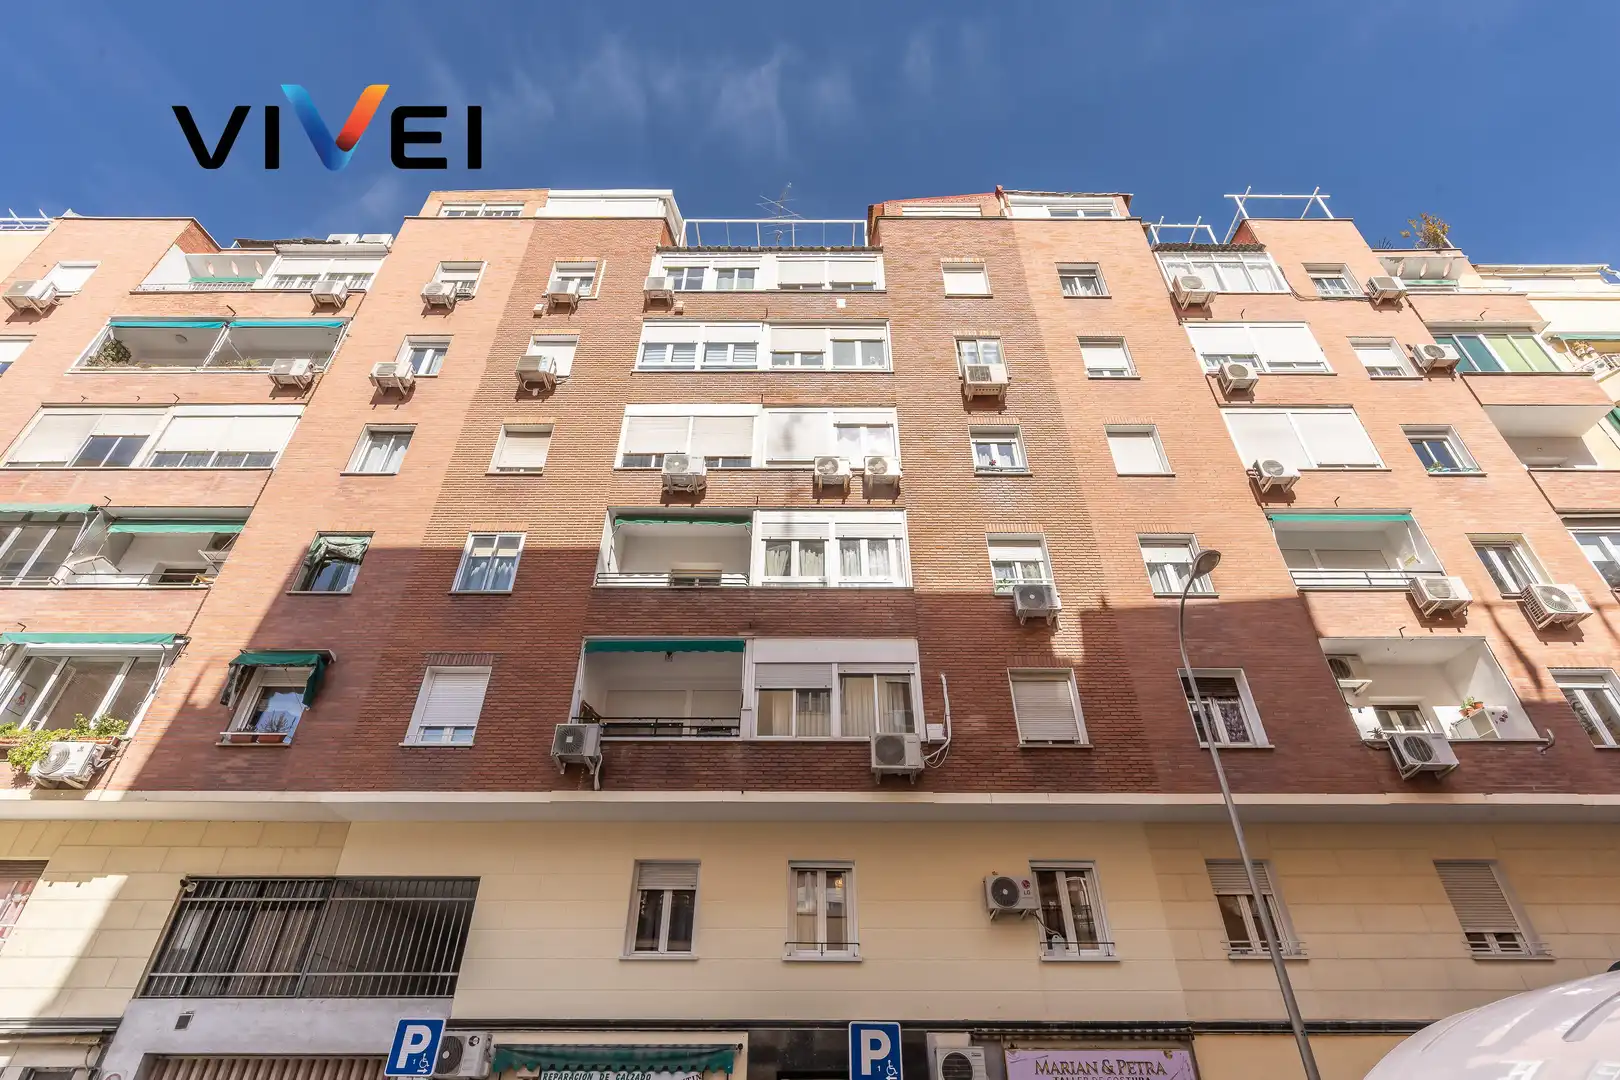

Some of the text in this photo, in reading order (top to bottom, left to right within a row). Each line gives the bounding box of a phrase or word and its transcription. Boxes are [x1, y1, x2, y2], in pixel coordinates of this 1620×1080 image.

[395, 1025, 432, 1069] P
[860, 1029, 891, 1075] P
[1035, 1059, 1168, 1075] MARIAN & PETRA
